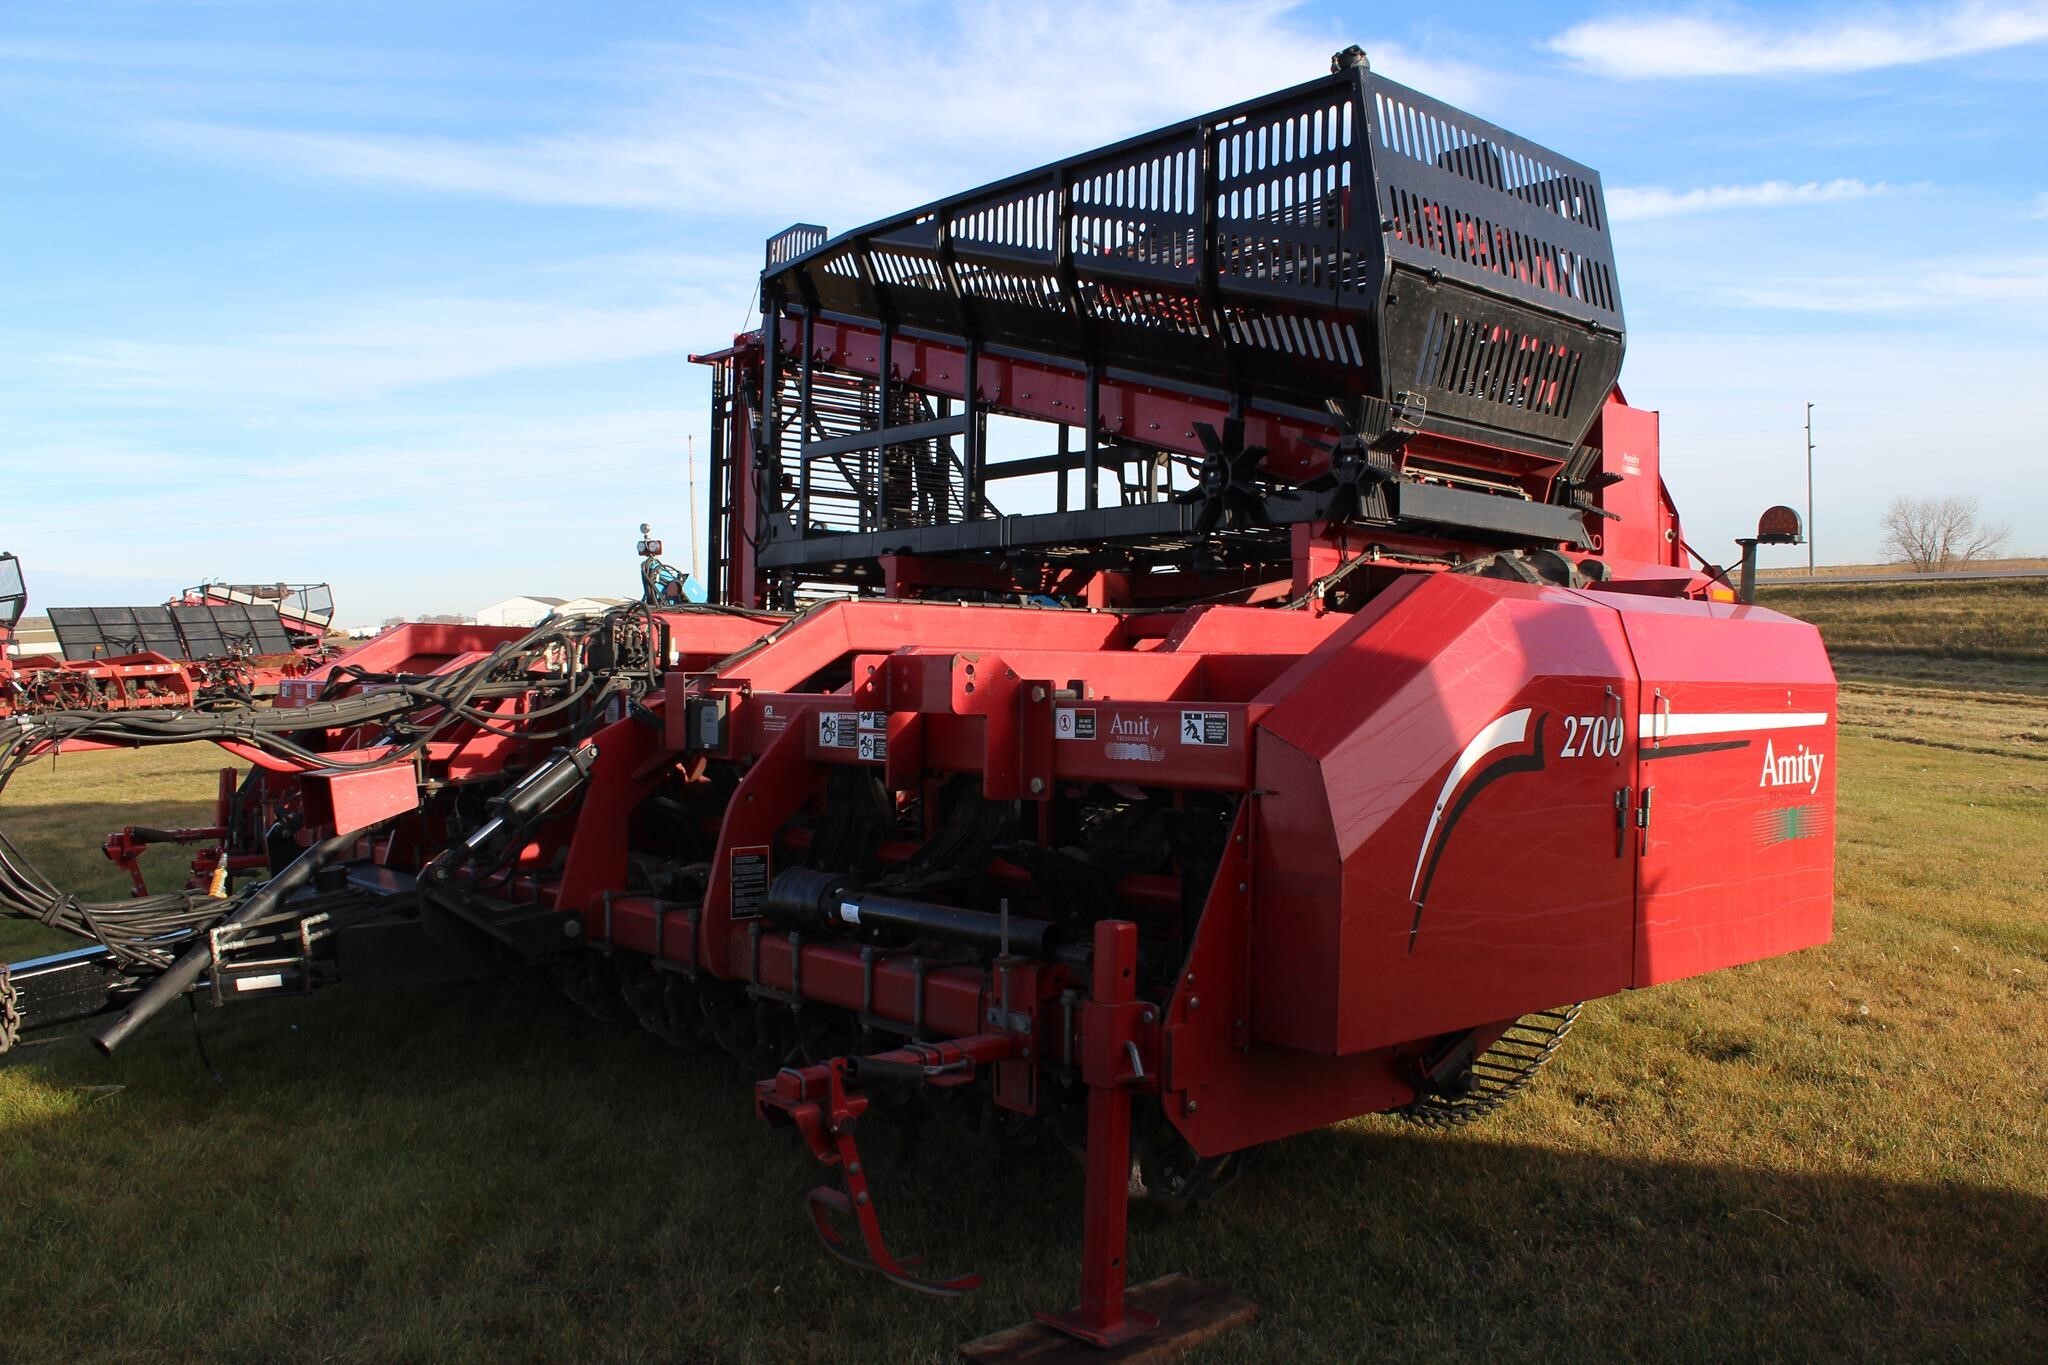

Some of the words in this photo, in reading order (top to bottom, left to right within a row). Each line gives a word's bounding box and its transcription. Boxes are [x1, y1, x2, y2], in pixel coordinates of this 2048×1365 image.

[1110, 713, 1158, 738] Amity
[1560, 715, 1624, 757] 2700
[1760, 738, 1824, 795] Amity
